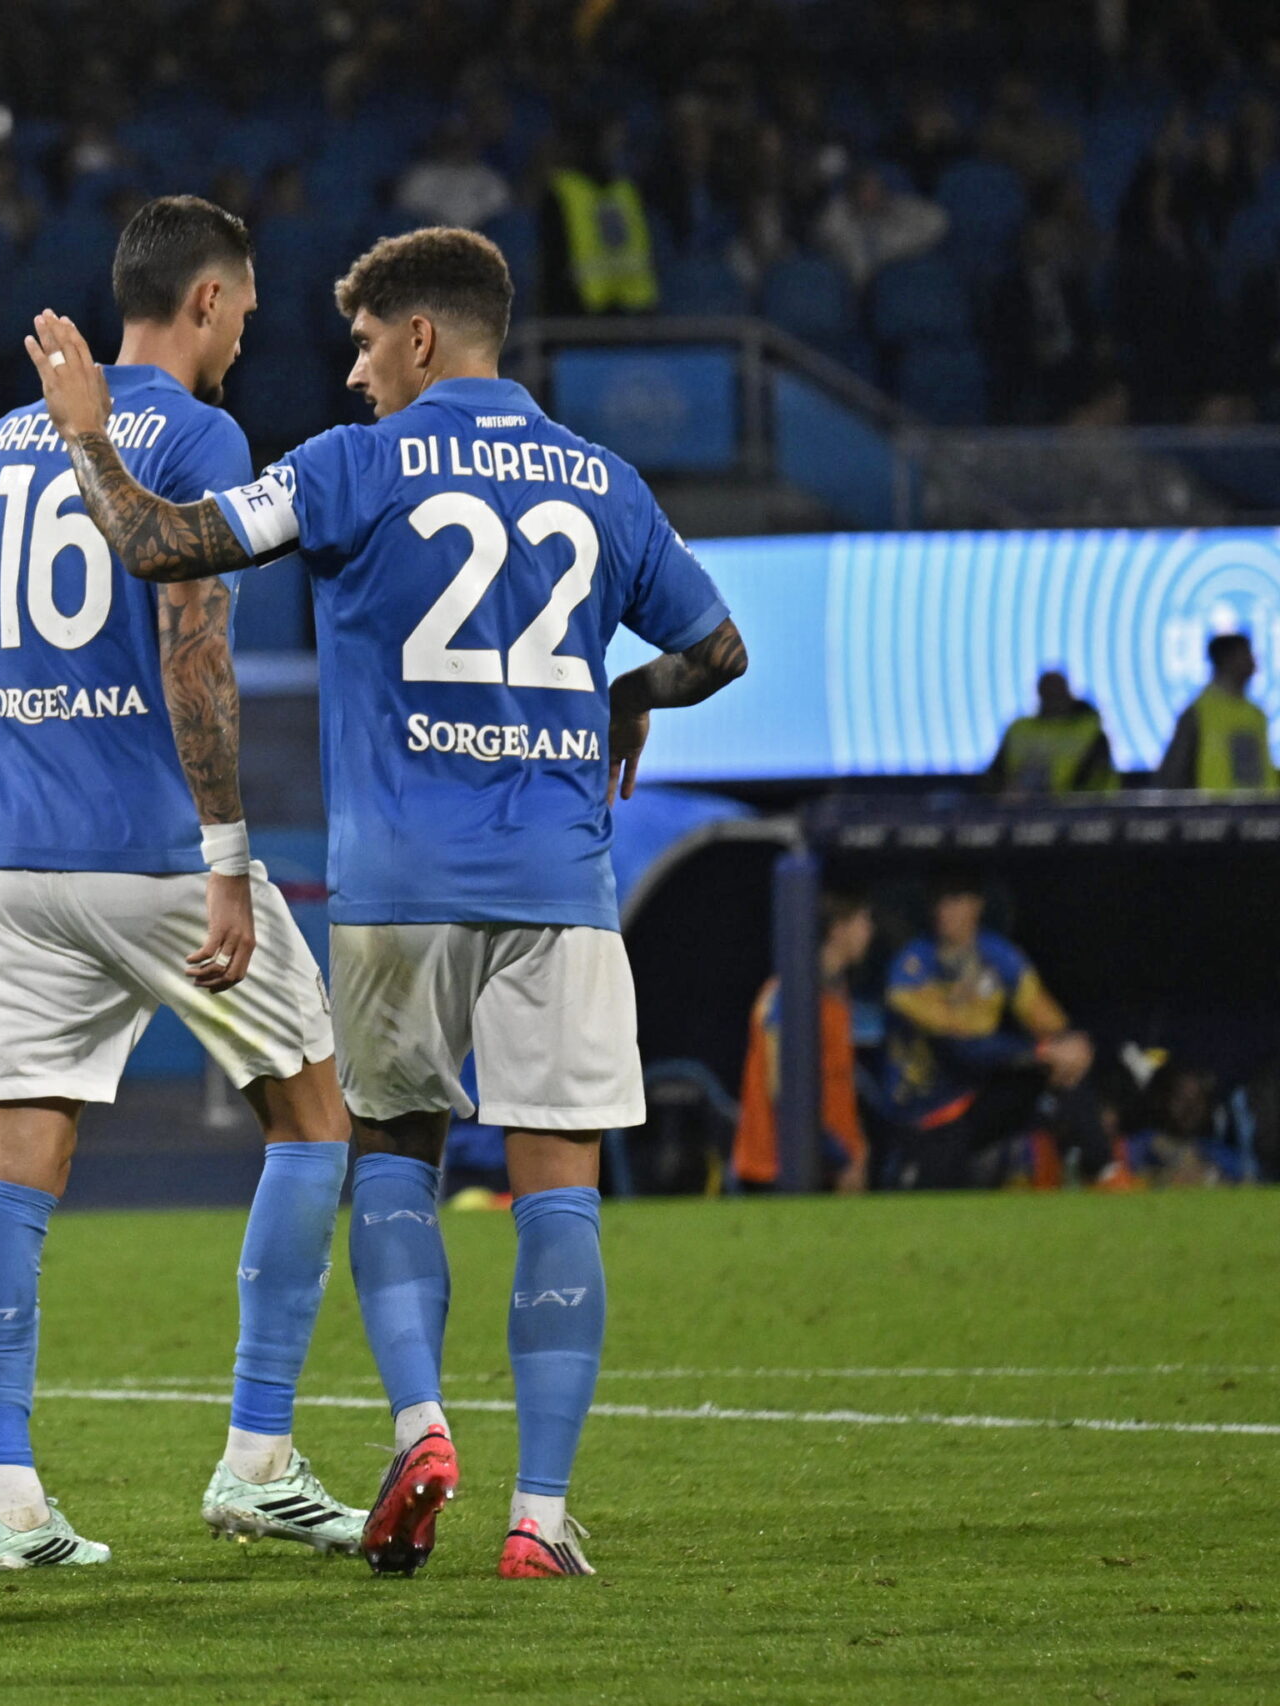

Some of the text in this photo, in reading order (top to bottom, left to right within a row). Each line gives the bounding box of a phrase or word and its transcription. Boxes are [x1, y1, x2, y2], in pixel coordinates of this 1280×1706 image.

[400, 435, 609, 496] DI LORENZO
[402, 491, 600, 692] 22
[407, 713, 600, 762] SORGESANA
[514, 1287, 587, 1309] EA7
